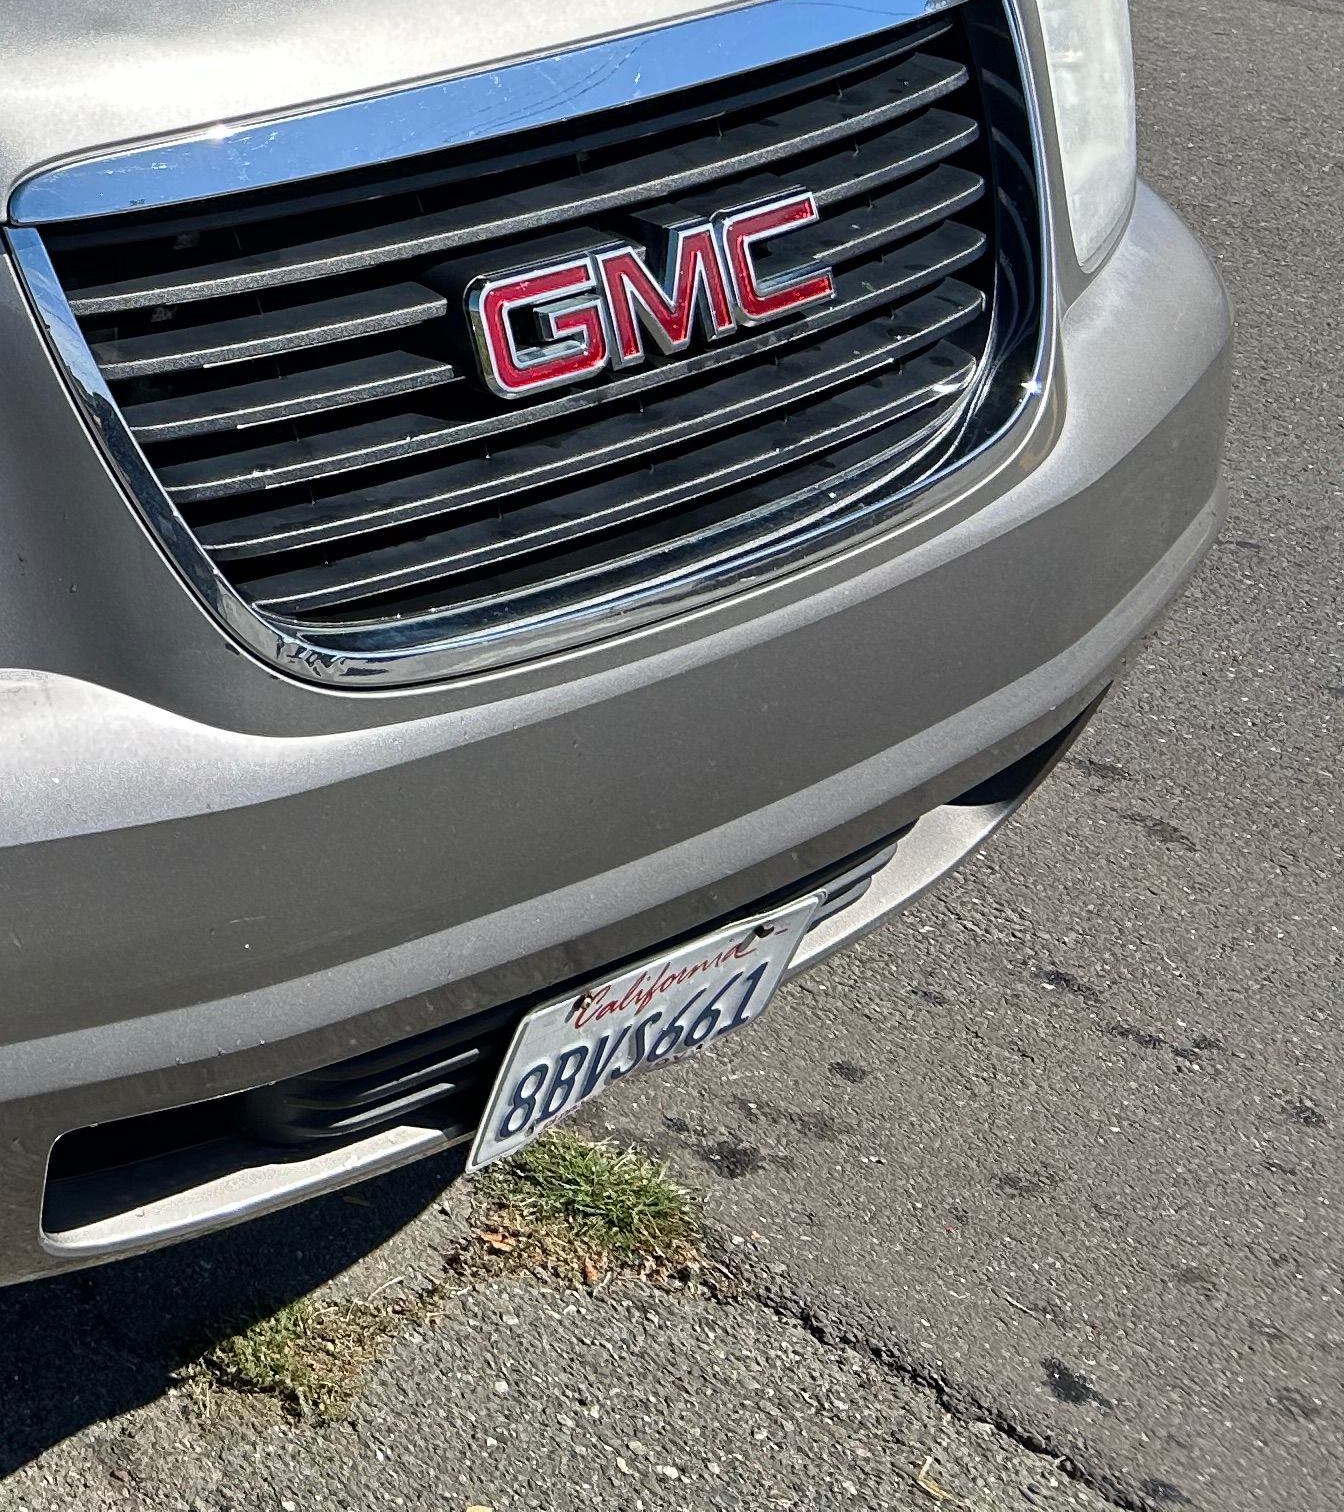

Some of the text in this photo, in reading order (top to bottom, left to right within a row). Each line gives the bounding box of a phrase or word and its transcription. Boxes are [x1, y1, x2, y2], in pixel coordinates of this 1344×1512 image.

[468, 186, 836, 399] GMC
[498, 962, 769, 1139] 8BVS661
[574, 938, 757, 1029] California
